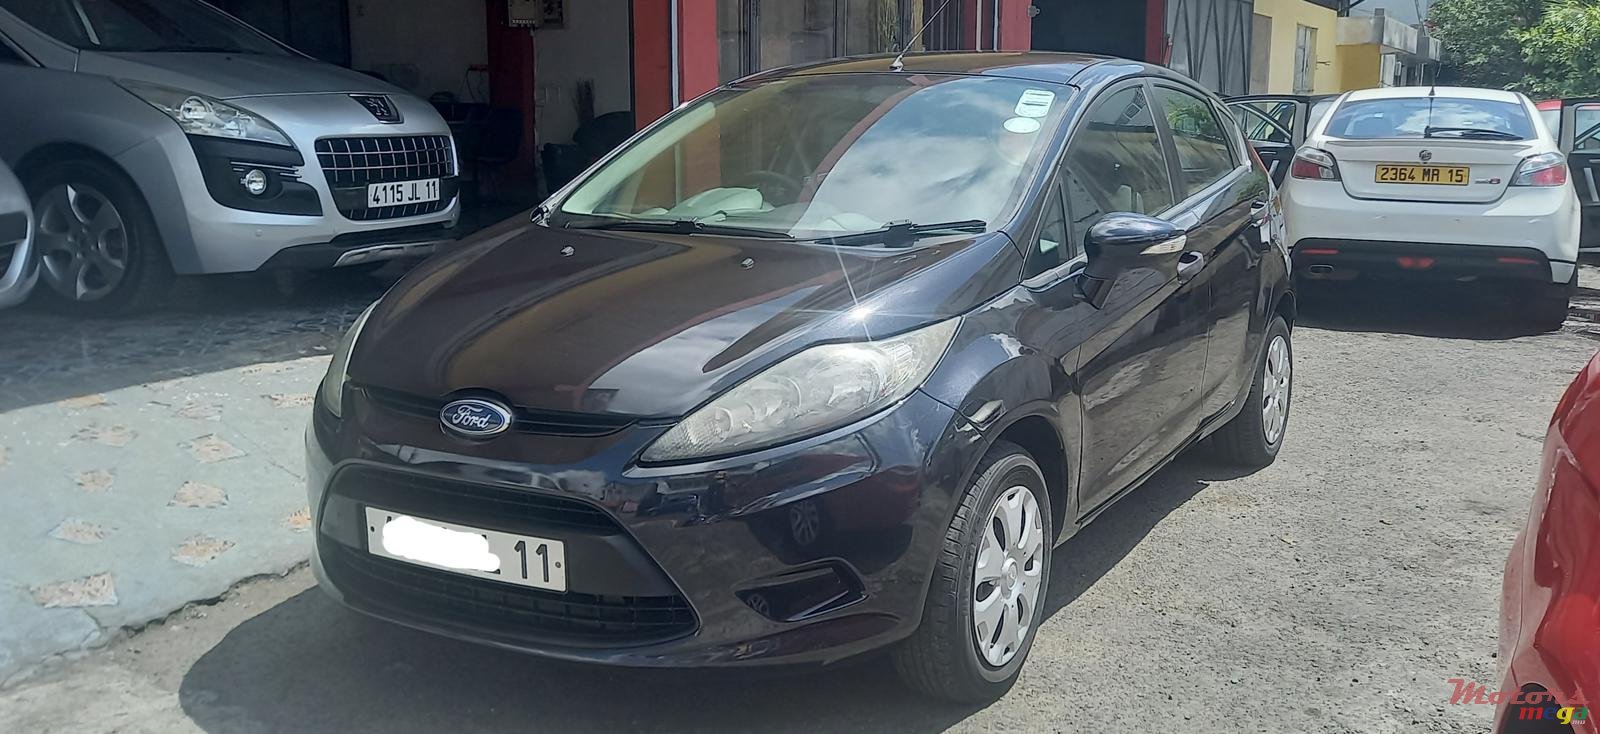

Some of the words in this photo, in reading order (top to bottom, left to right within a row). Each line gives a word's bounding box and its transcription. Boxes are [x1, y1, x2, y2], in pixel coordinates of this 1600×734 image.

[1380, 167, 1415, 181] 2364
[1448, 169, 1464, 183] 15
[373, 184, 403, 204] 4115
[408, 183, 421, 201] JL
[426, 180, 437, 199] 11
[452, 404, 491, 428] Ford
[514, 540, 549, 583] 11
